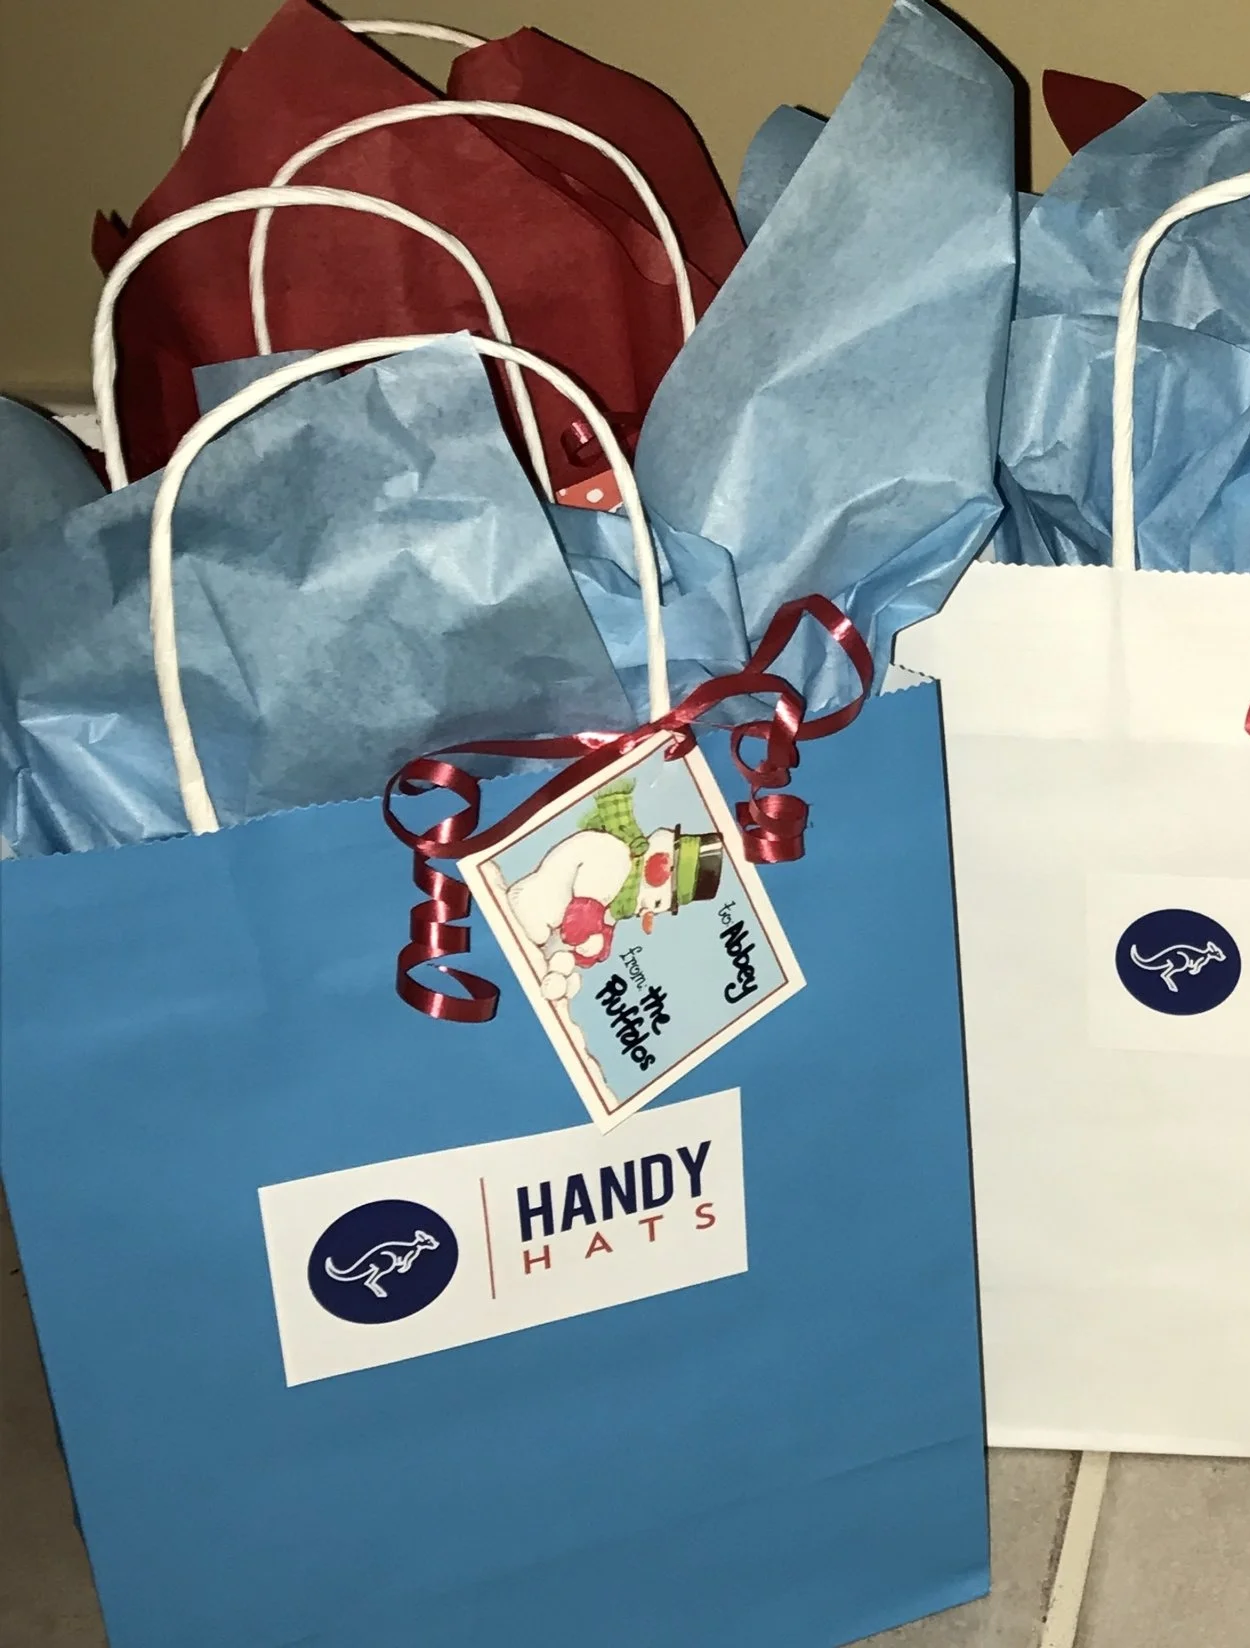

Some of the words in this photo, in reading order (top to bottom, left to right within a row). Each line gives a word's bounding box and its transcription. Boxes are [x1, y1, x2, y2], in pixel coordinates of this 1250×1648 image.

[719, 920, 758, 1003] Abbey
[640, 985, 671, 1035] the
[516, 1140, 712, 1242] HANDY
[522, 1202, 717, 1275] HATS
